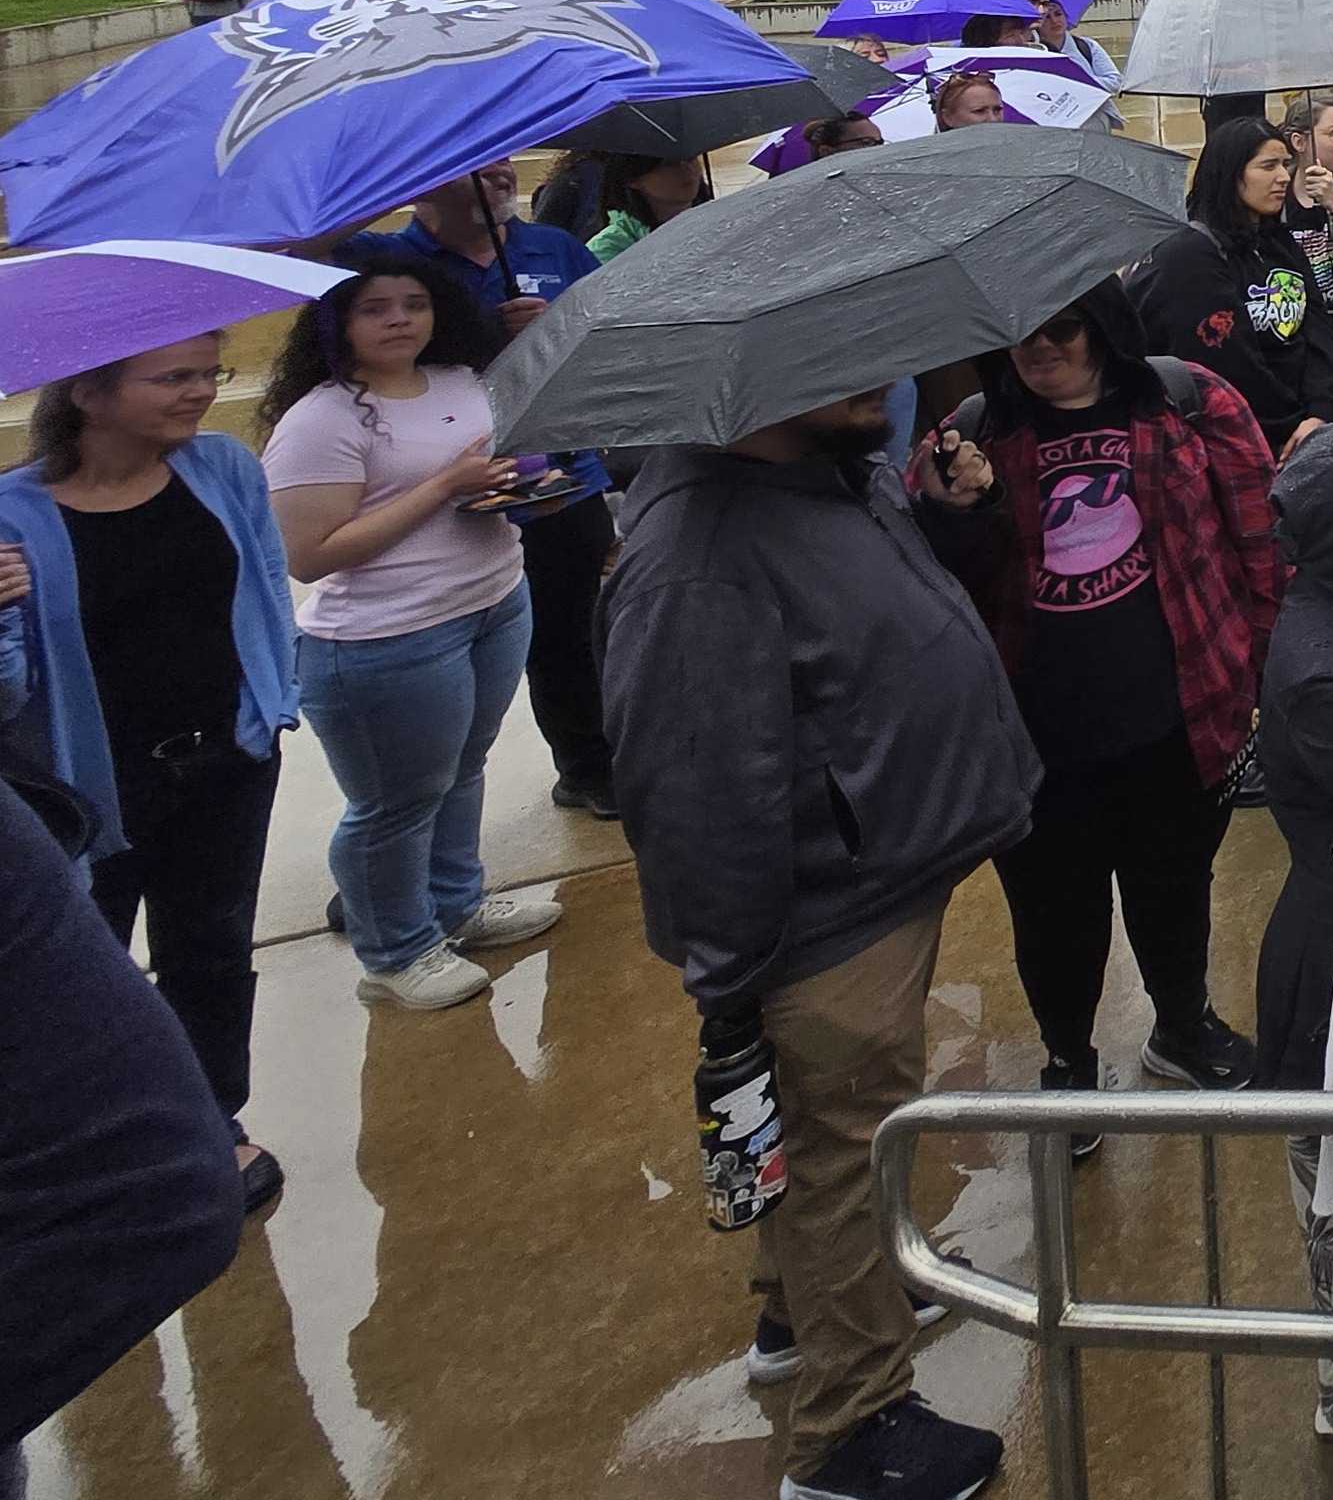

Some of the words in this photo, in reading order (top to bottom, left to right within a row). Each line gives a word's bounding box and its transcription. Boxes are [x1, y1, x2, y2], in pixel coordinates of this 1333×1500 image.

[1082, 438, 1094, 456] A
[1052, 579, 1068, 600] A
[1078, 544, 1149, 603] SHARK
